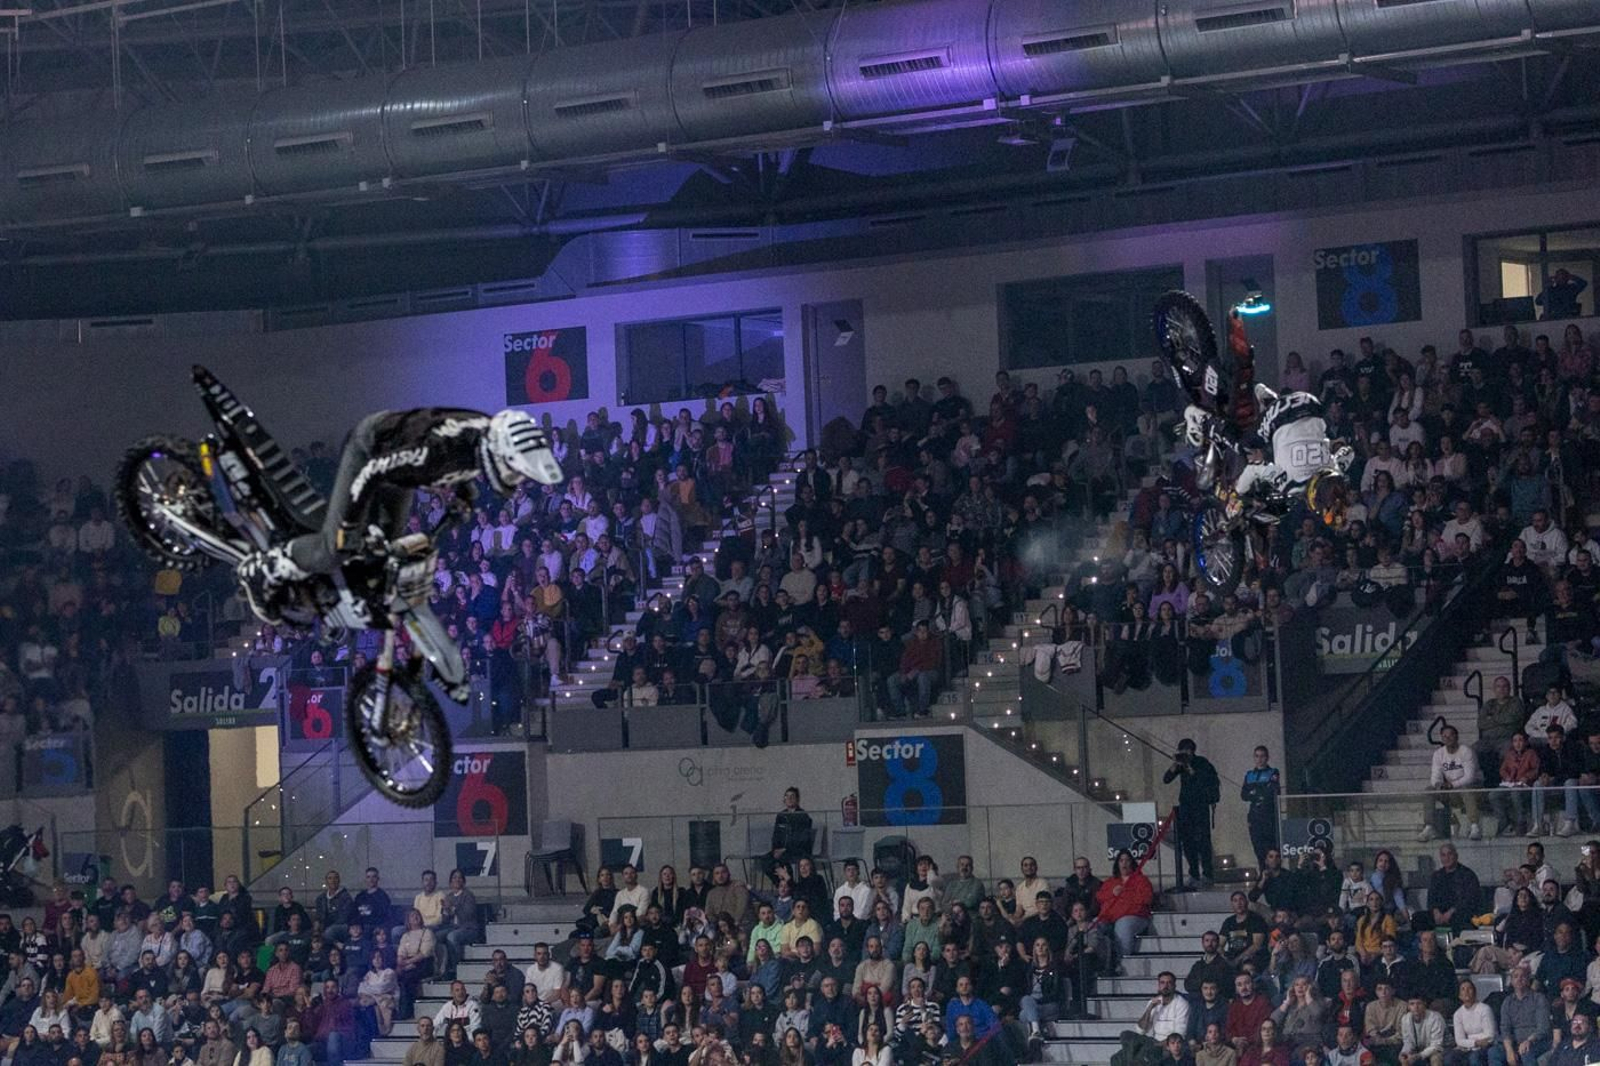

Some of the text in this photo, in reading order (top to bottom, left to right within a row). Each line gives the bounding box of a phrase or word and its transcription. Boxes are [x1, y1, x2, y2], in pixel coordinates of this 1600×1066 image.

[1314, 249, 1379, 270] Sector
[1341, 242, 1398, 326] 8
[504, 334, 556, 353] Sector
[525, 330, 571, 403] 6
[170, 667, 278, 714] Salida 2
[302, 690, 333, 740] 6
[453, 754, 491, 775] ctor
[857, 738, 925, 761] Sector
[456, 753, 509, 836] 6
[883, 736, 943, 825] 8
[622, 837, 642, 868] 7
[1131, 822, 1155, 860] 8
[1282, 843, 1315, 856] Secto
[1306, 817, 1334, 860] 8
[475, 841, 497, 877] 7
